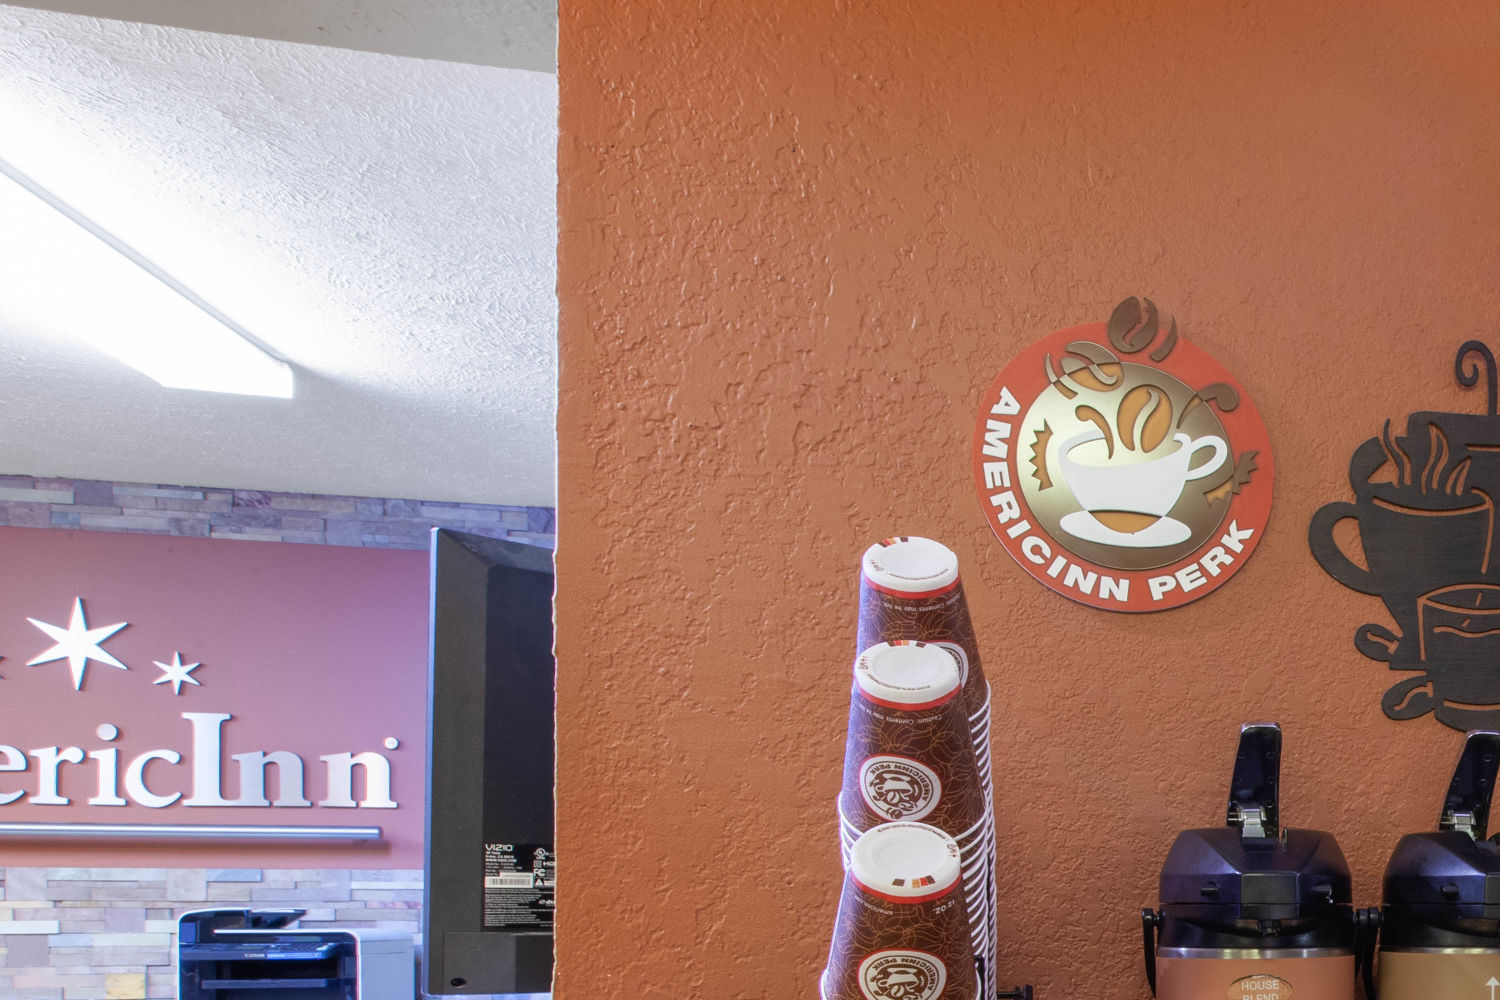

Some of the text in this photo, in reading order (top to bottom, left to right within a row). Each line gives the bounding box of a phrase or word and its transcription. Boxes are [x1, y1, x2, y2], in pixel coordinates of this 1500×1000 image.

[982, 386, 1255, 602] AMERICINN PERK
[868, 763, 932, 802] AMERICINN PERK
[485, 844, 514, 852] VIZIO
[872, 957, 938, 992] AMERICINN PERK
[1241, 979, 1280, 991] HOUSE
